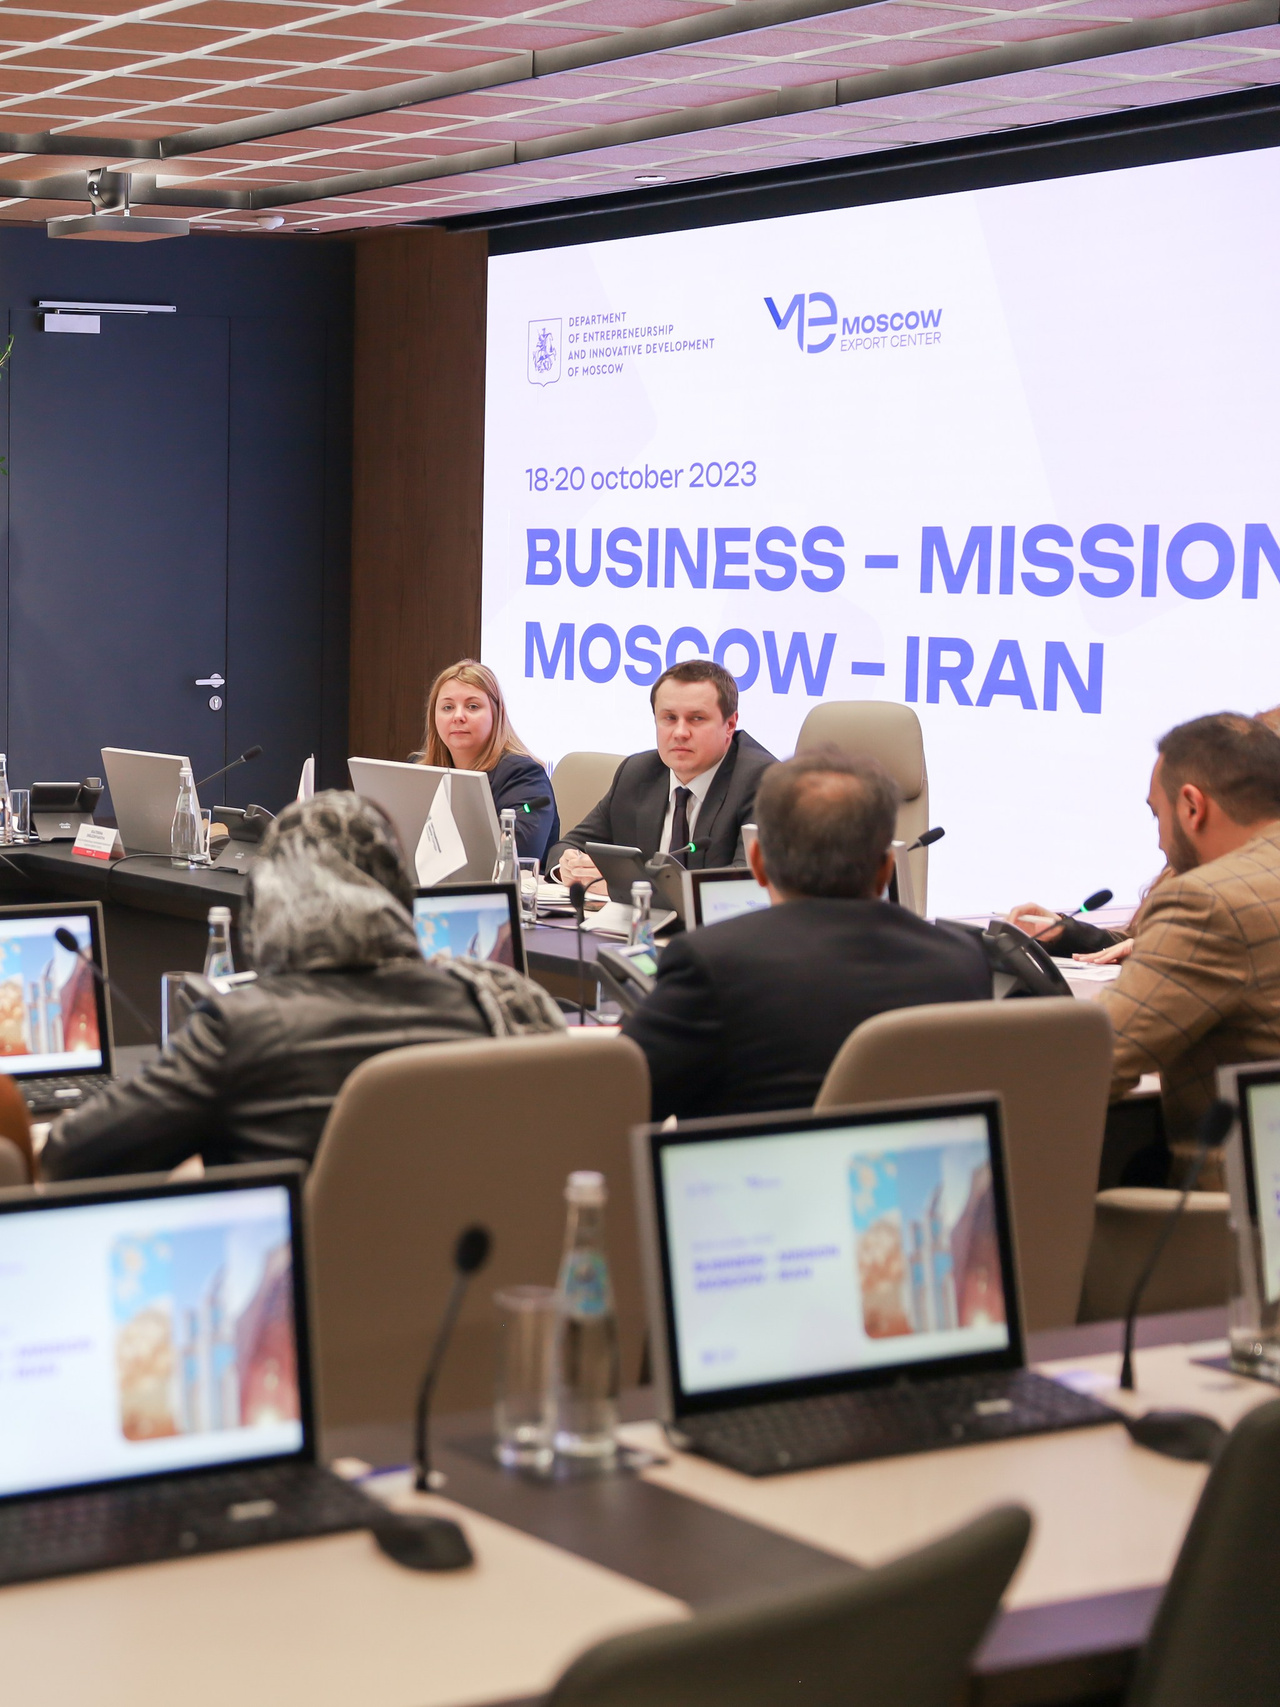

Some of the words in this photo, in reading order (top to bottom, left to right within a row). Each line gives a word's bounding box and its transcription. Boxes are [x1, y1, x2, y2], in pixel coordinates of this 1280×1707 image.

[568, 311, 627, 328] DEPARTMENT
[842, 308, 943, 336] MOSCOW
[568, 333, 580, 344] OF
[582, 324, 674, 343] ENTREPRENEURSHIP
[840, 335, 888, 352] EXPORT
[890, 331, 942, 348] CENTER
[567, 349, 587, 361] AND
[589, 344, 643, 359] INNOVATIVE
[645, 338, 715, 355] DEVELOPMENT
[567, 366, 580, 378] OF
[581, 363, 624, 377] MOSCOW
[525, 466, 586, 492] 18-20
[590, 463, 685, 491] october
[688, 460, 757, 488] 2023
[525, 526, 846, 593] BUSINESS
[904, 635, 1104, 715] IRAN
